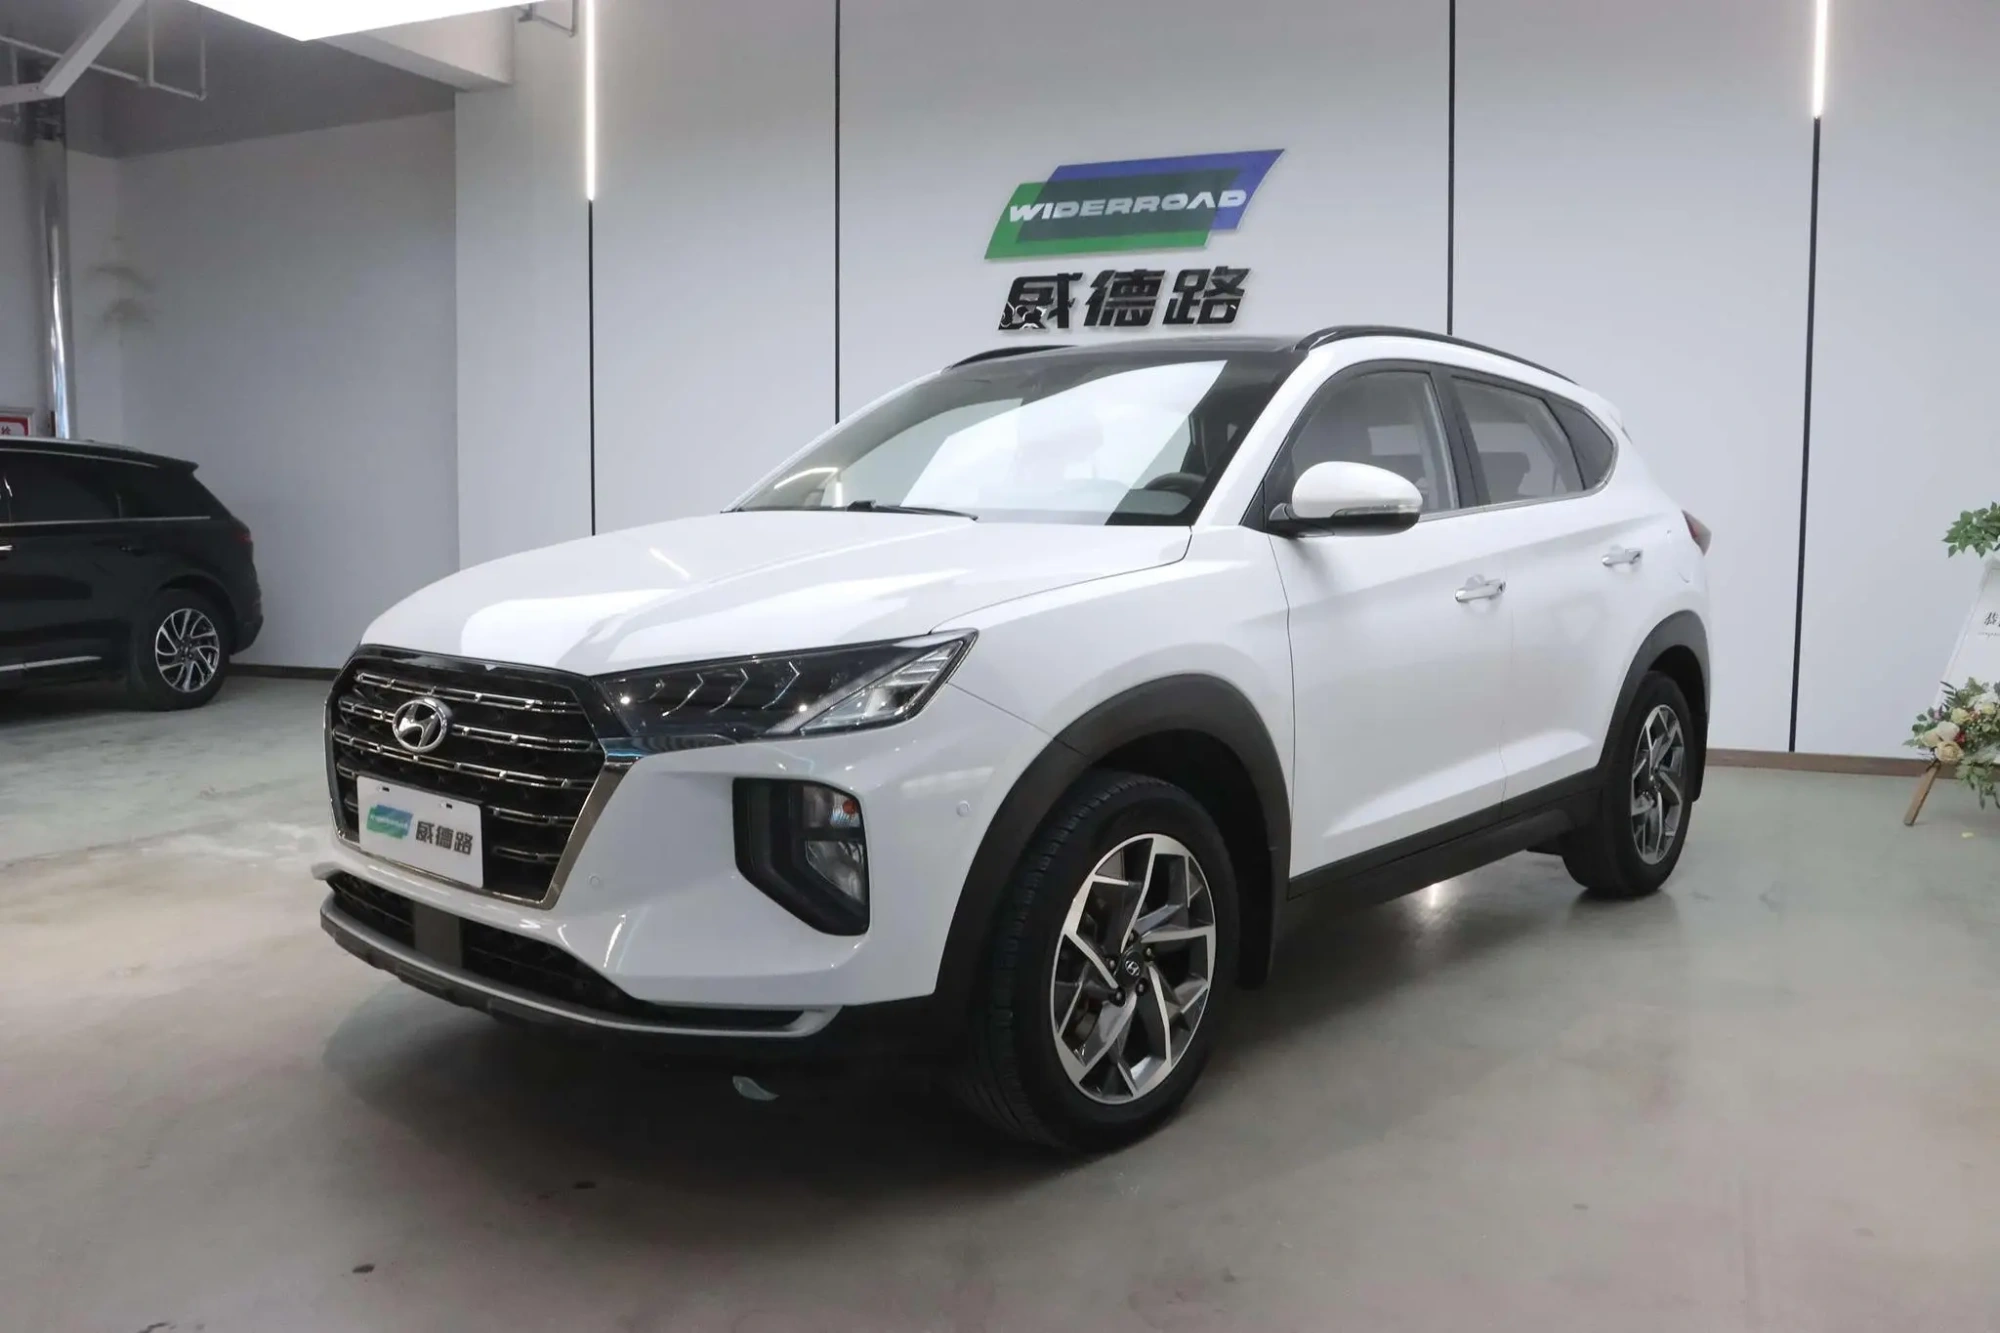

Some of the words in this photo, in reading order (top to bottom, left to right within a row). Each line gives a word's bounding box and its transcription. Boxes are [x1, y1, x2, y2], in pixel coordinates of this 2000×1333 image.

[1010, 189, 1247, 222] WIDERROAD
[998, 266, 1251, 329] 威德路
